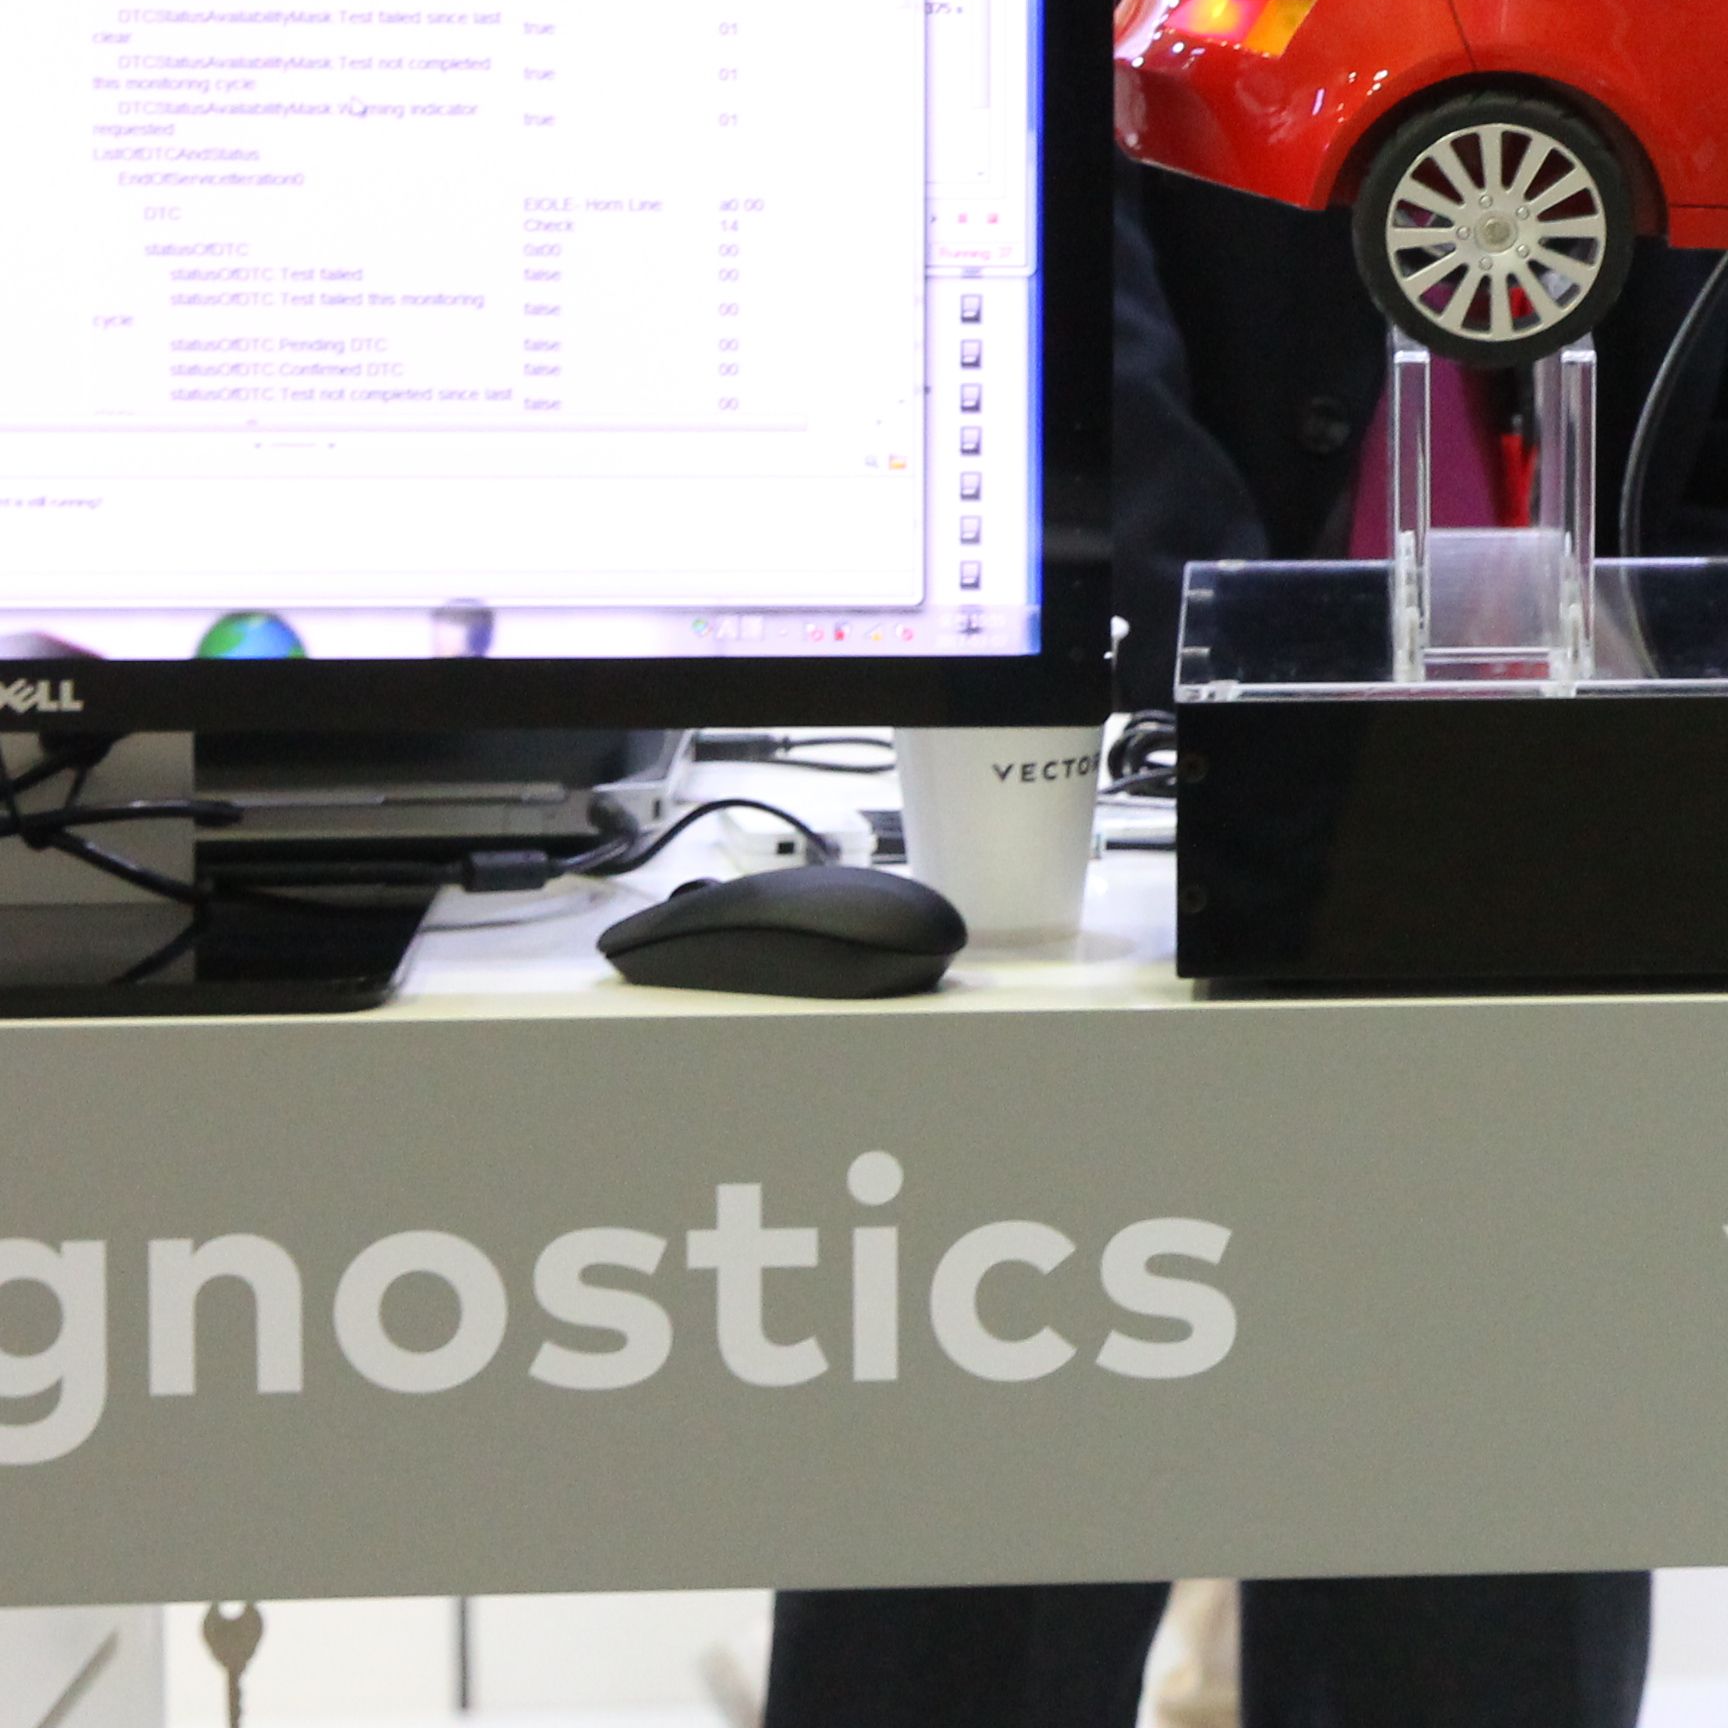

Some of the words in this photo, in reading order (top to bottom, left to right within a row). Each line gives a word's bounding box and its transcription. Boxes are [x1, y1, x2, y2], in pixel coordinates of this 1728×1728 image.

[522, 22, 557, 35] true
[717, 22, 739, 36] 01
[522, 67, 557, 80] true
[717, 68, 739, 81] 01
[522, 113, 557, 126] true
[717, 112, 739, 127] 01
[742, 198, 765, 212] 00
[717, 244, 741, 257] 00
[522, 268, 563, 282] false
[717, 268, 741, 282] 00
[522, 303, 562, 316] false
[717, 303, 741, 316] 00
[522, 338, 563, 352] false
[717, 338, 741, 352] 00
[522, 363, 562, 376] false
[717, 363, 740, 376] 00
[522, 398, 563, 411] false
[717, 397, 741, 411] 00
[0, 678, 84, 713] ELL
